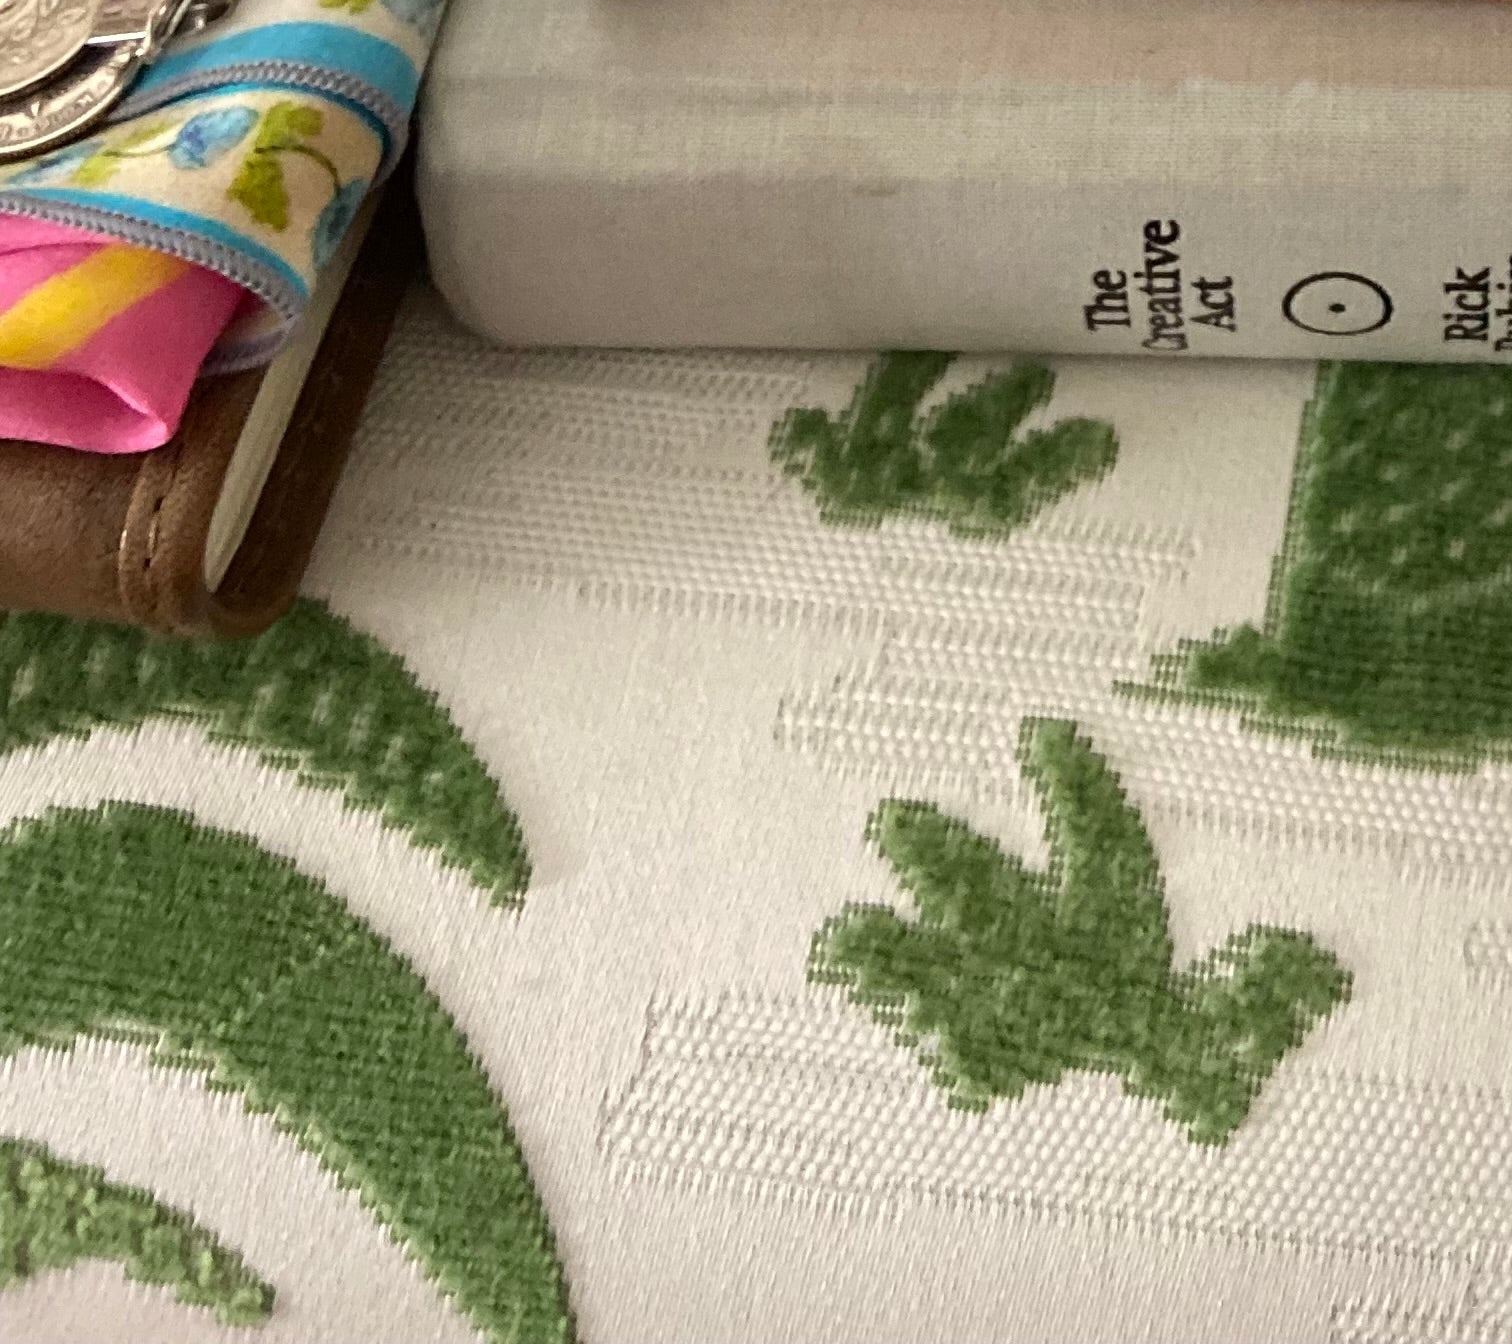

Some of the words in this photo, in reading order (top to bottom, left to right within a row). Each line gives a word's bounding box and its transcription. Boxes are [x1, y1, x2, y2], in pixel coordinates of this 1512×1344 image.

[1084, 268, 1132, 331] The
[1134, 218, 1189, 352] Creative
[1191, 274, 1238, 333] Act
[1443, 265, 1493, 343] Rick
